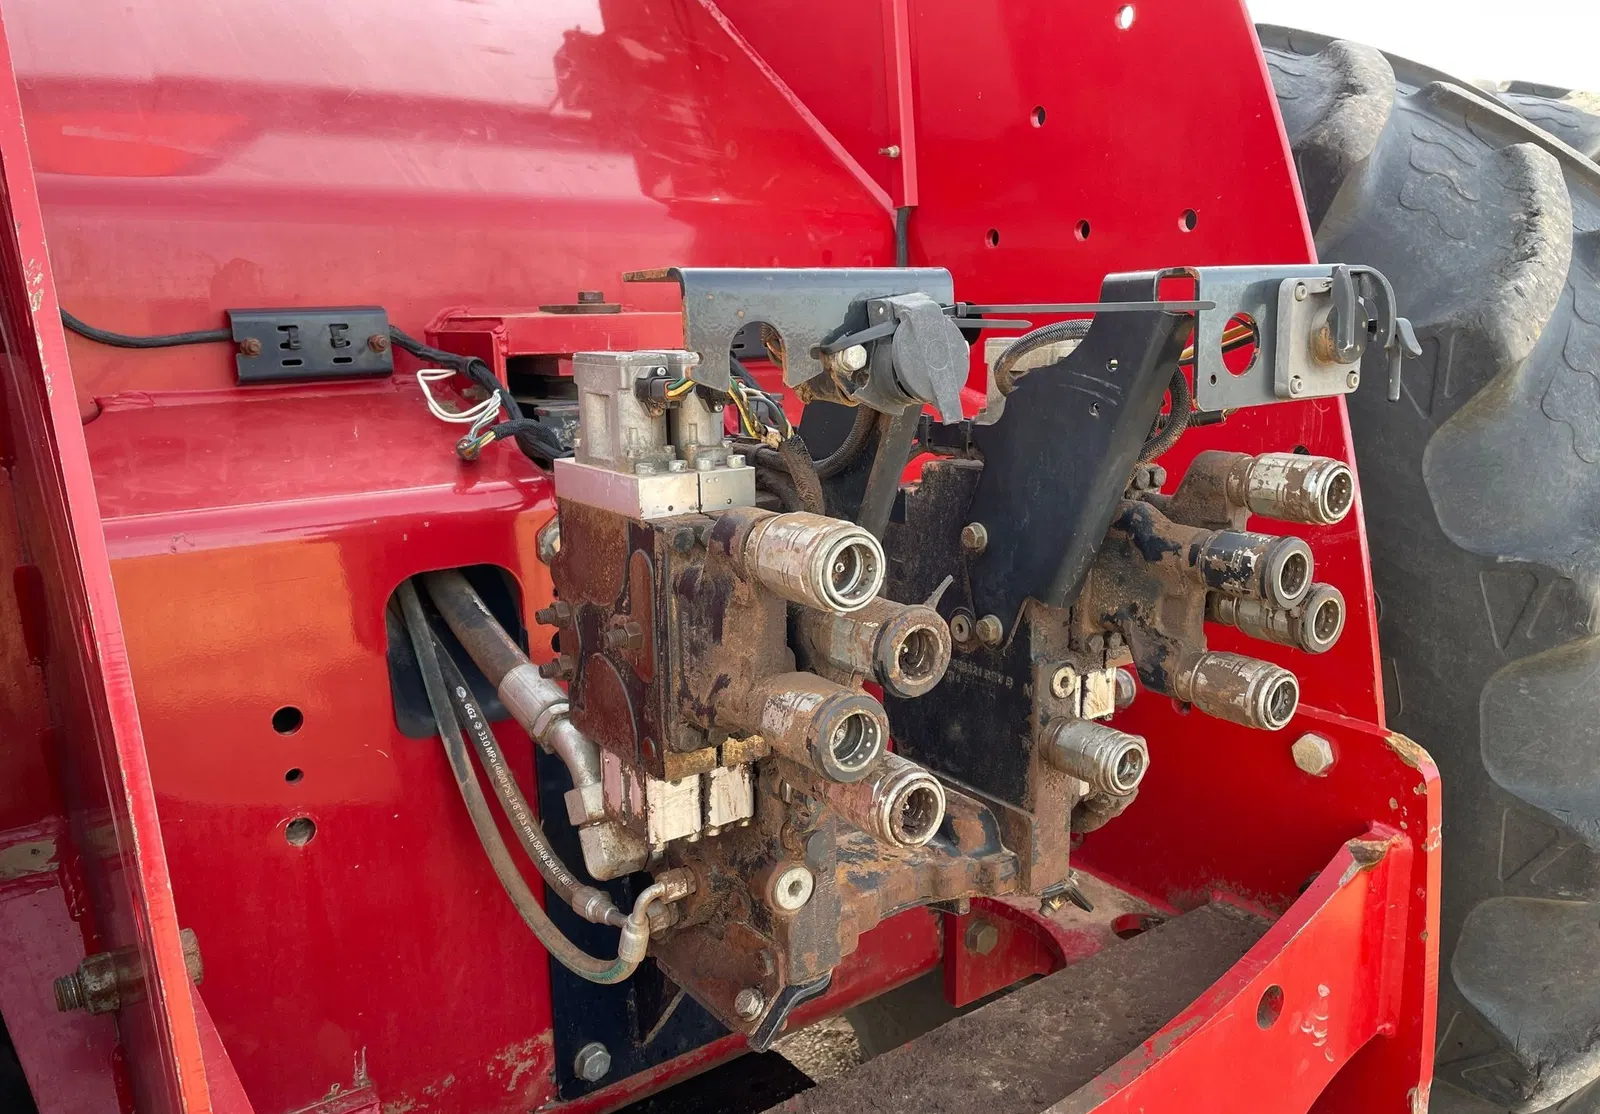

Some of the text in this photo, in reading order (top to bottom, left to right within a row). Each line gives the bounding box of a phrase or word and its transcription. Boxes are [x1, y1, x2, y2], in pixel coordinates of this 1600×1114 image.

[464, 703, 477, 720] 6G2
[478, 731, 491, 747] 33.0
[485, 746, 497, 763] MPa
[492, 762, 508, 784] (4800
[502, 783, 515, 798] PSI)
[524, 825, 538, 843] mm)
